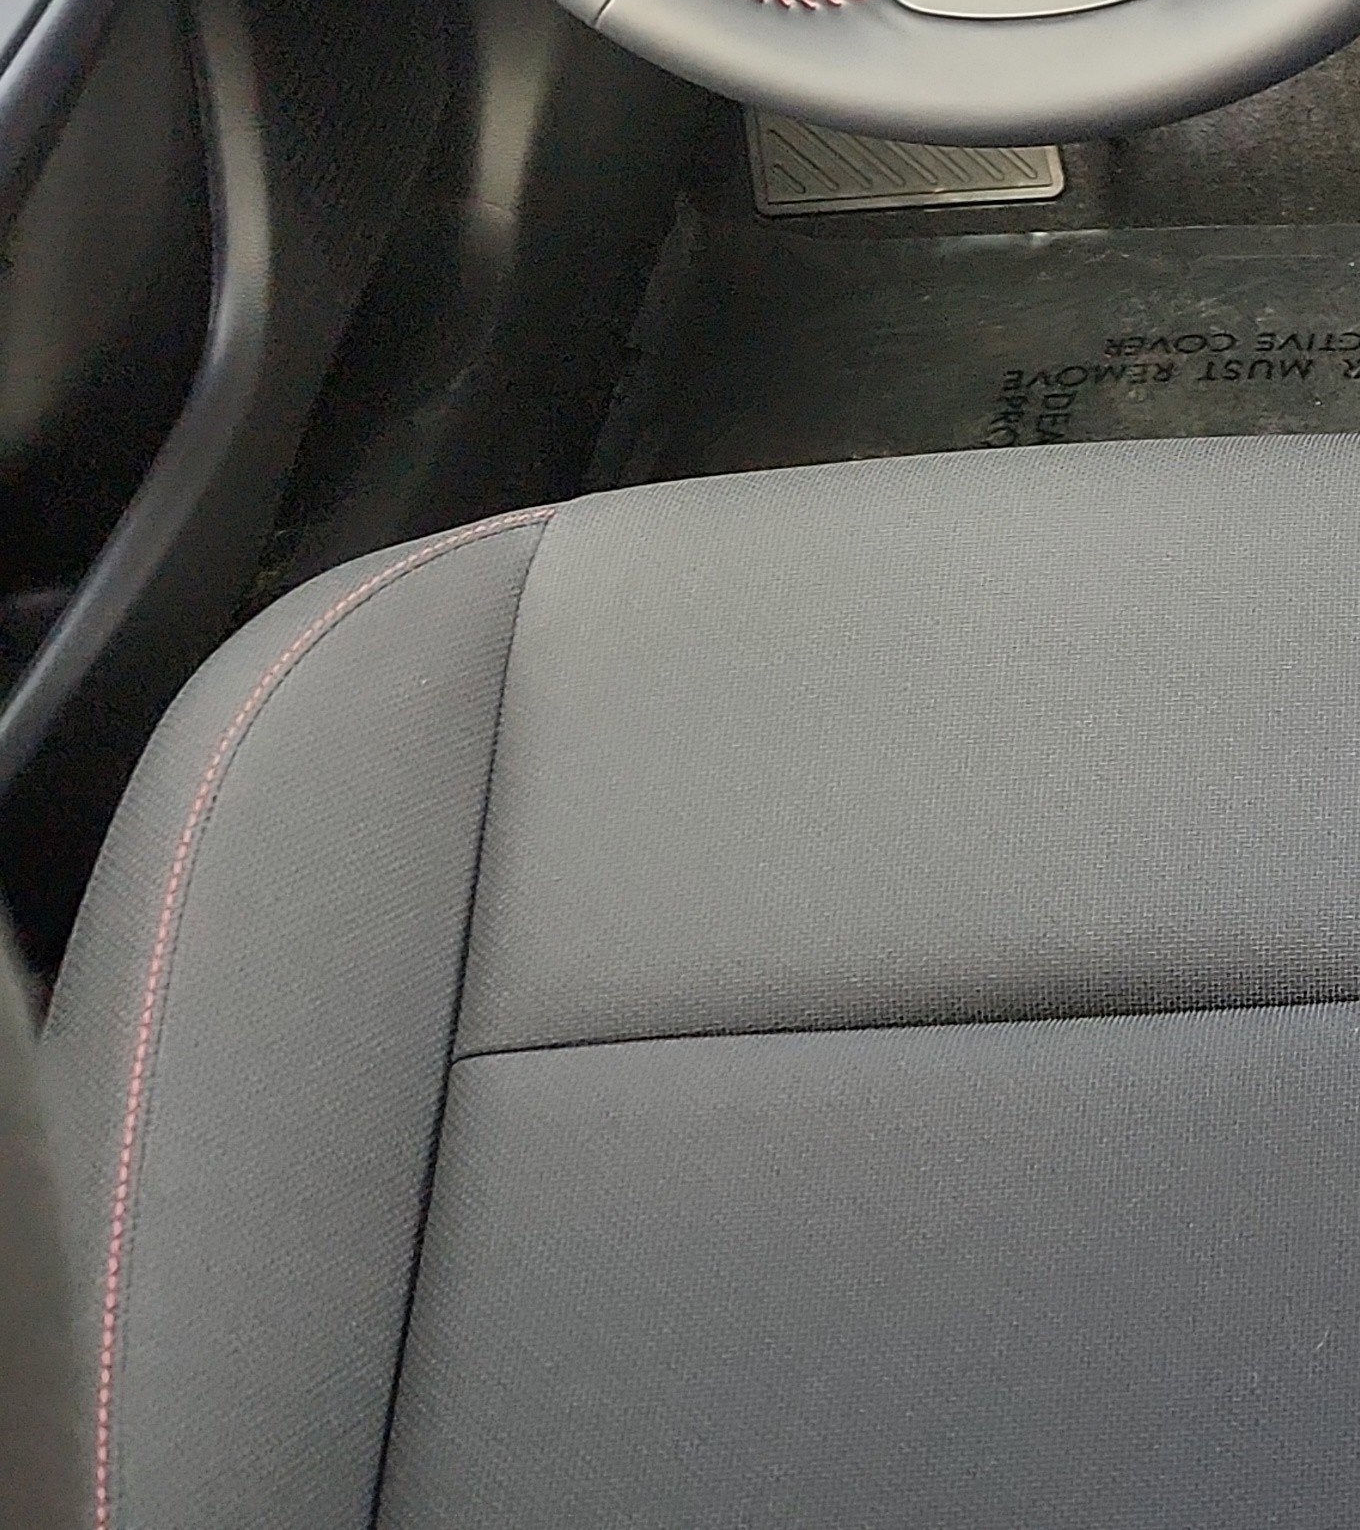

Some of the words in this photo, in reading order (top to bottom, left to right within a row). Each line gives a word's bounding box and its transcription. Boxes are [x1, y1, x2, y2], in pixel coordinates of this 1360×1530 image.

[1103, 330, 1238, 357] COVER
[1002, 359, 1177, 392] REMOVE
[1199, 356, 1314, 382] MUST
